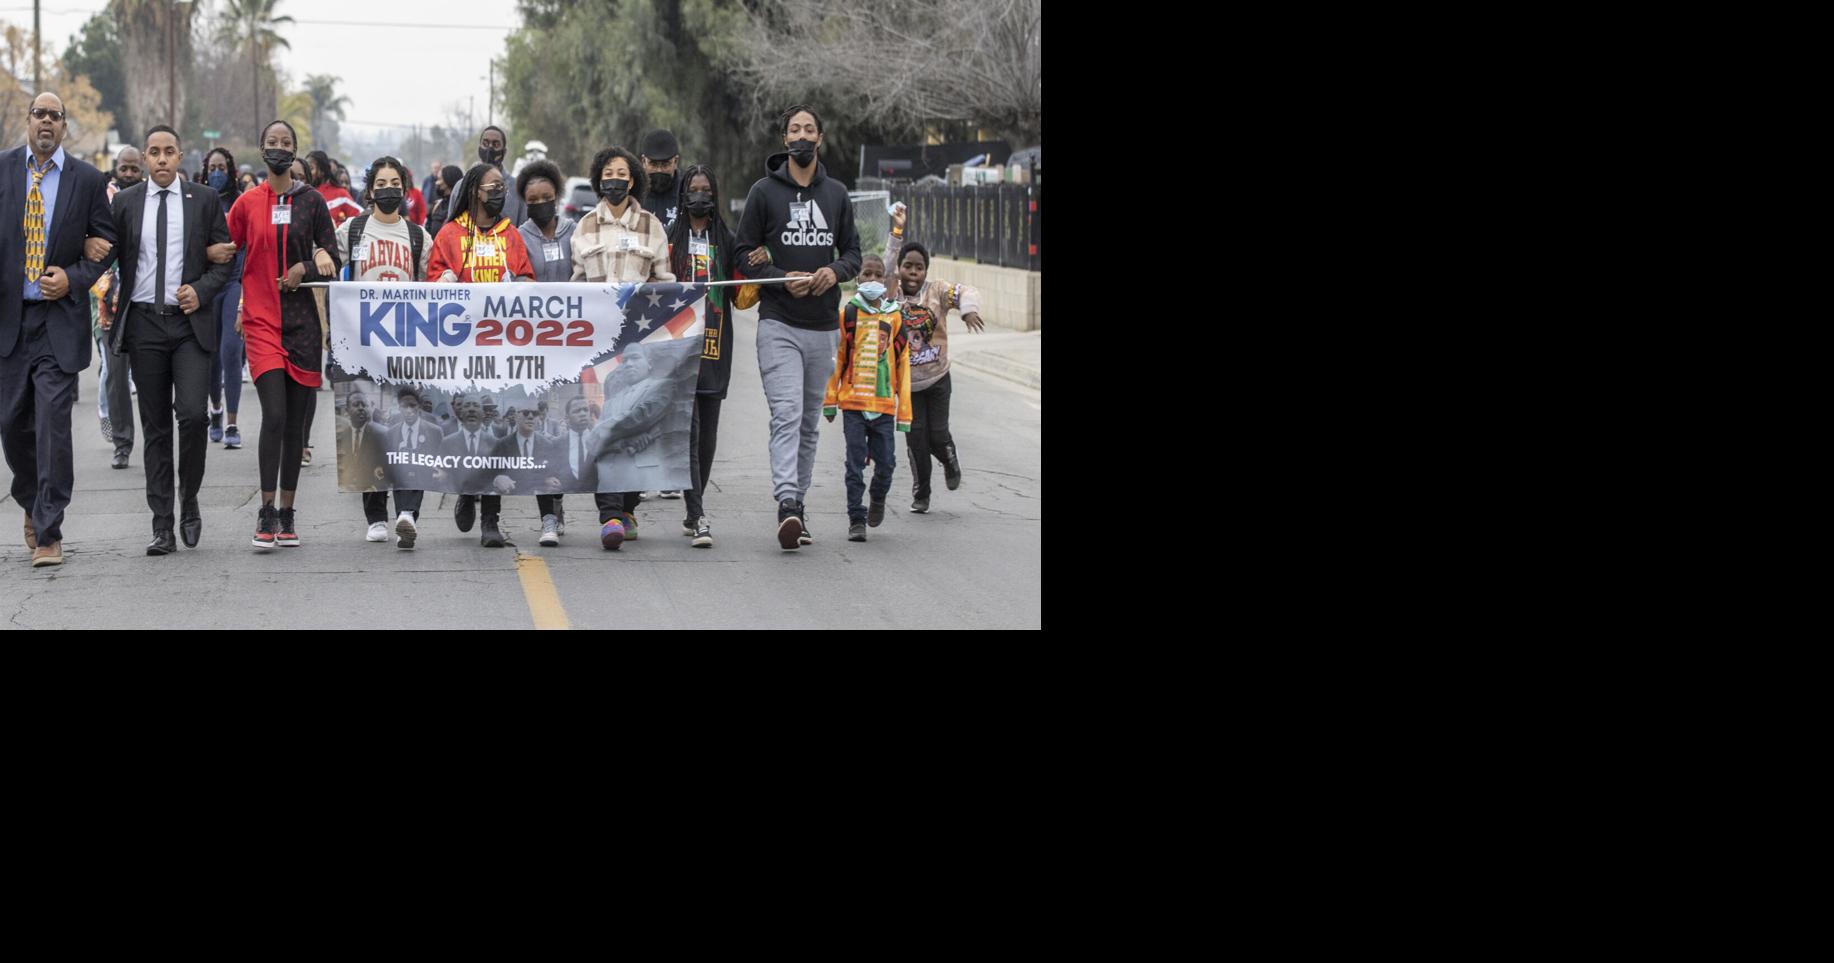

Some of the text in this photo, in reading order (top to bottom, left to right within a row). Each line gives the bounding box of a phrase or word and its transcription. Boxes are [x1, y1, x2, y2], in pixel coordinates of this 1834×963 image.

[781, 228, 834, 246] adidas
[360, 289, 471, 300] DR. MARTIN LUTHER
[483, 295, 583, 319] MARCH
[360, 302, 472, 347] KING
[475, 319, 595, 347] 2022
[387, 356, 545, 380] MONDAY JAN. 17TH
[386, 452, 547, 469] THE LEGACY CONTINUES...
